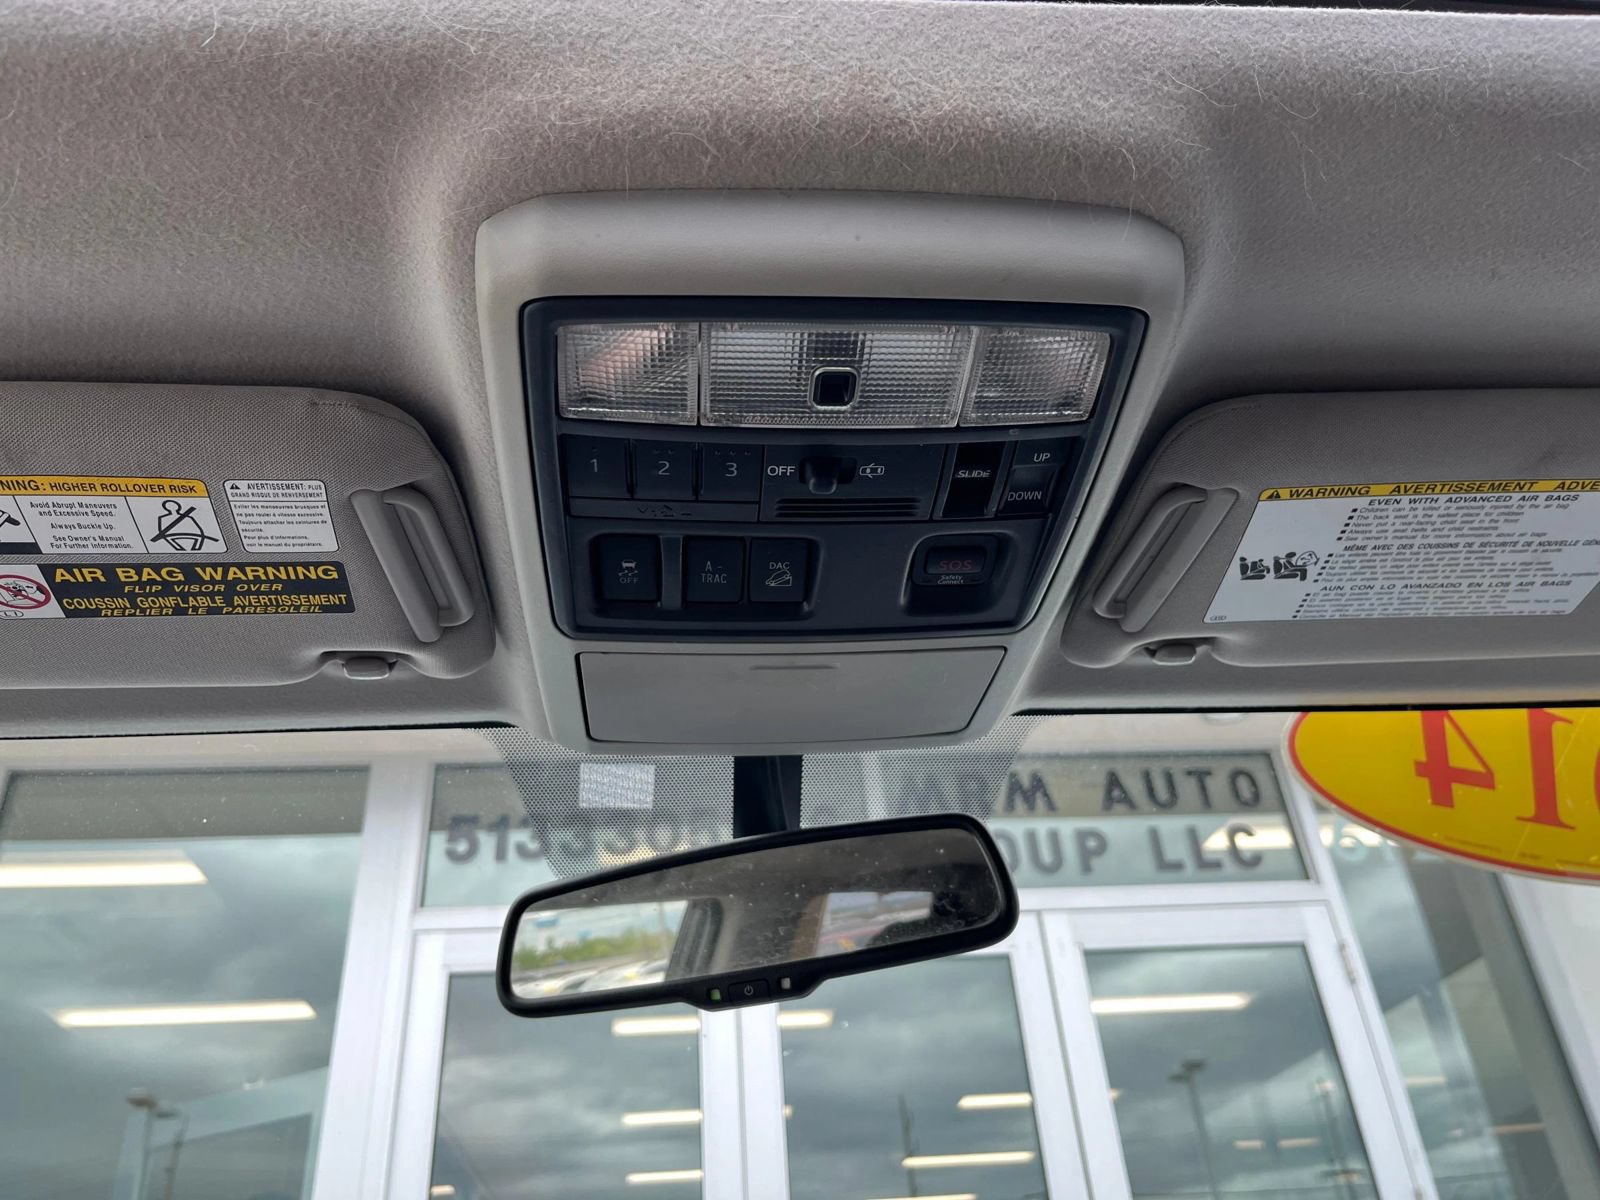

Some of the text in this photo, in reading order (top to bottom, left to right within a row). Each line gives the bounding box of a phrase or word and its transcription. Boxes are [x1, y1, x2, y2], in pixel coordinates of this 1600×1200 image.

[1033, 452, 1051, 462] UP
[590, 458, 598, 473] 1
[658, 460, 670, 475] 2
[725, 462, 738, 477] 3
[767, 465, 796, 476] OFF
[957, 469, 991, 478] SLIDE
[49, 482, 98, 492] HIGHER
[101, 483, 167, 493] ROLLOVER
[169, 484, 198, 494] RISK
[1289, 485, 1371, 498] WARNING
[1389, 481, 1539, 495] AVERTISSEMENT
[1007, 491, 1043, 501] DOWN
[1368, 498, 1402, 506] EVEN
[1408, 496, 1440, 505] WITH
[1444, 495, 1512, 504] ADVANCED
[1544, 494, 1580, 502] BAGS
[29, 501, 50, 509] Avoid
[52, 501, 76, 510] Abrupt
[39, 509, 52, 517] and
[53, 509, 89, 517] Excessive
[50, 522, 76, 531] Always
[78, 522, 101, 530] Buckle
[1343, 543, 1369, 551] MÊME
[1371, 543, 1394, 551] AVEC
[1417, 541, 1460, 549] COUSSINS
[769, 561, 790, 570] DAC
[939, 560, 973, 571] SOS
[55, 565, 339, 583] AIR BAG WARNING
[701, 573, 727, 584] TRAC
[124, 583, 283, 593] FLIP VISOR OVER
[1400, 581, 1462, 589] AVANZADO
[63, 594, 347, 609] COUSSIN GONFLABLE AVERTISSEMENT
[101, 605, 323, 617] REPLIER LE PARESOLEIL
[1100, 768, 1262, 811] AUTO
[1147, 823, 1263, 872] LLC
